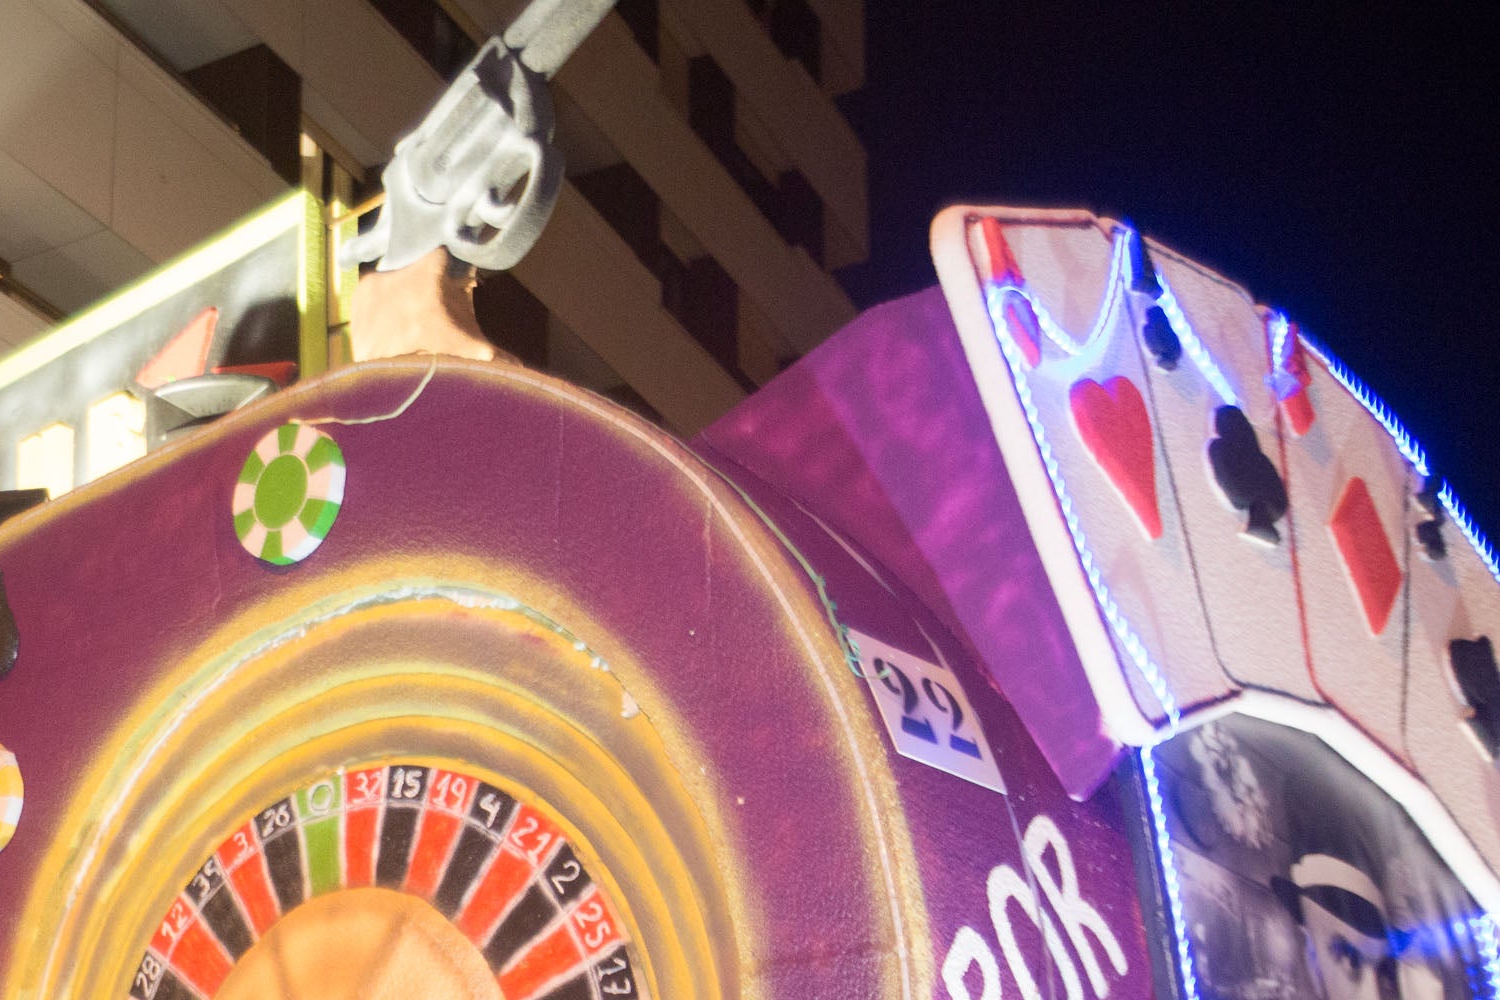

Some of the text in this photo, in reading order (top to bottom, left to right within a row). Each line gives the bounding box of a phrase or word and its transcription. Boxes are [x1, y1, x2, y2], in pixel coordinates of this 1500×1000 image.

[873, 658, 983, 761] 22
[308, 782, 334, 814] 0
[391, 767, 422, 798] 15
[432, 773, 467, 811] 19
[262, 805, 292, 837] 26
[479, 793, 502, 828] 4
[511, 817, 551, 866] 21
[551, 860, 580, 894] 2
[161, 903, 189, 941] 12
[574, 902, 611, 947] 25
[136, 954, 161, 997] 28
[598, 957, 631, 994] 17
